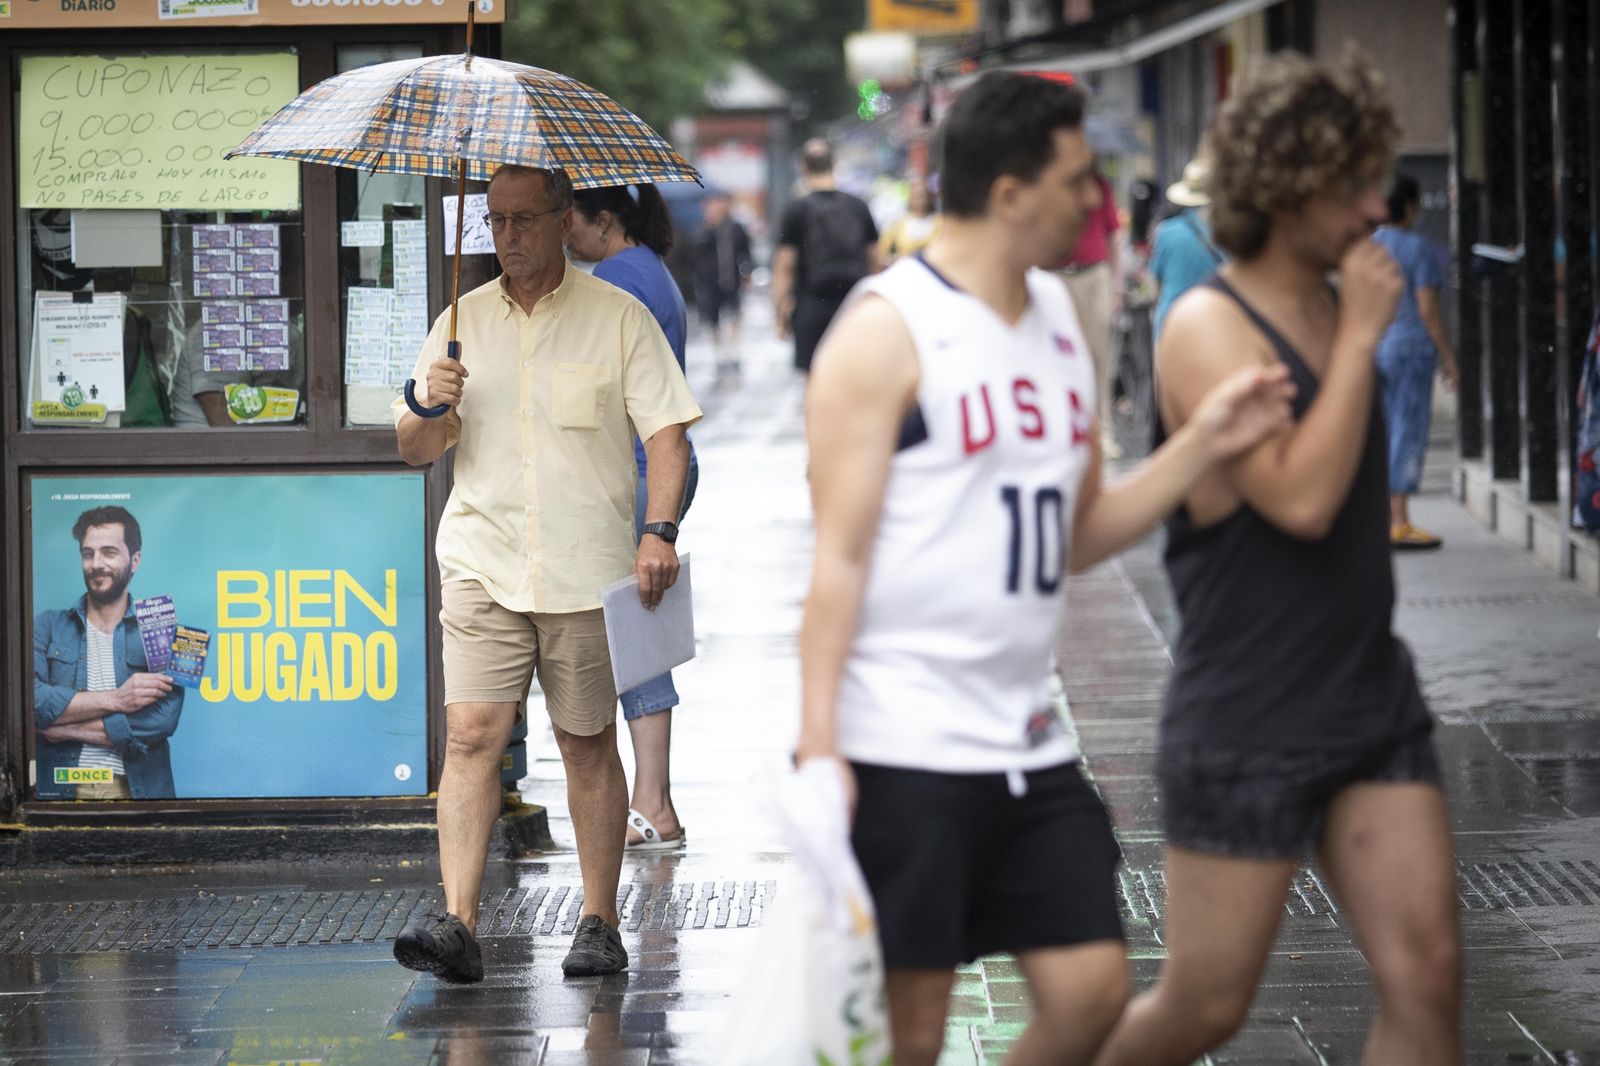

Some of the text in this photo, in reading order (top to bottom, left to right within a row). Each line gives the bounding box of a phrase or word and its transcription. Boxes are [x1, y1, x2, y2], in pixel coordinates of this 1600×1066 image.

[43, 63, 270, 100] CUPONAZO
[35, 187, 269, 204] NO PASES DE LARGO
[36, 167, 267, 188] COMPRALO HOY MISMO
[999, 485, 1066, 595] 10
[217, 568, 398, 628] BIEN
[199, 630, 398, 703] JUGADO
[71, 770, 109, 780] ONCE
